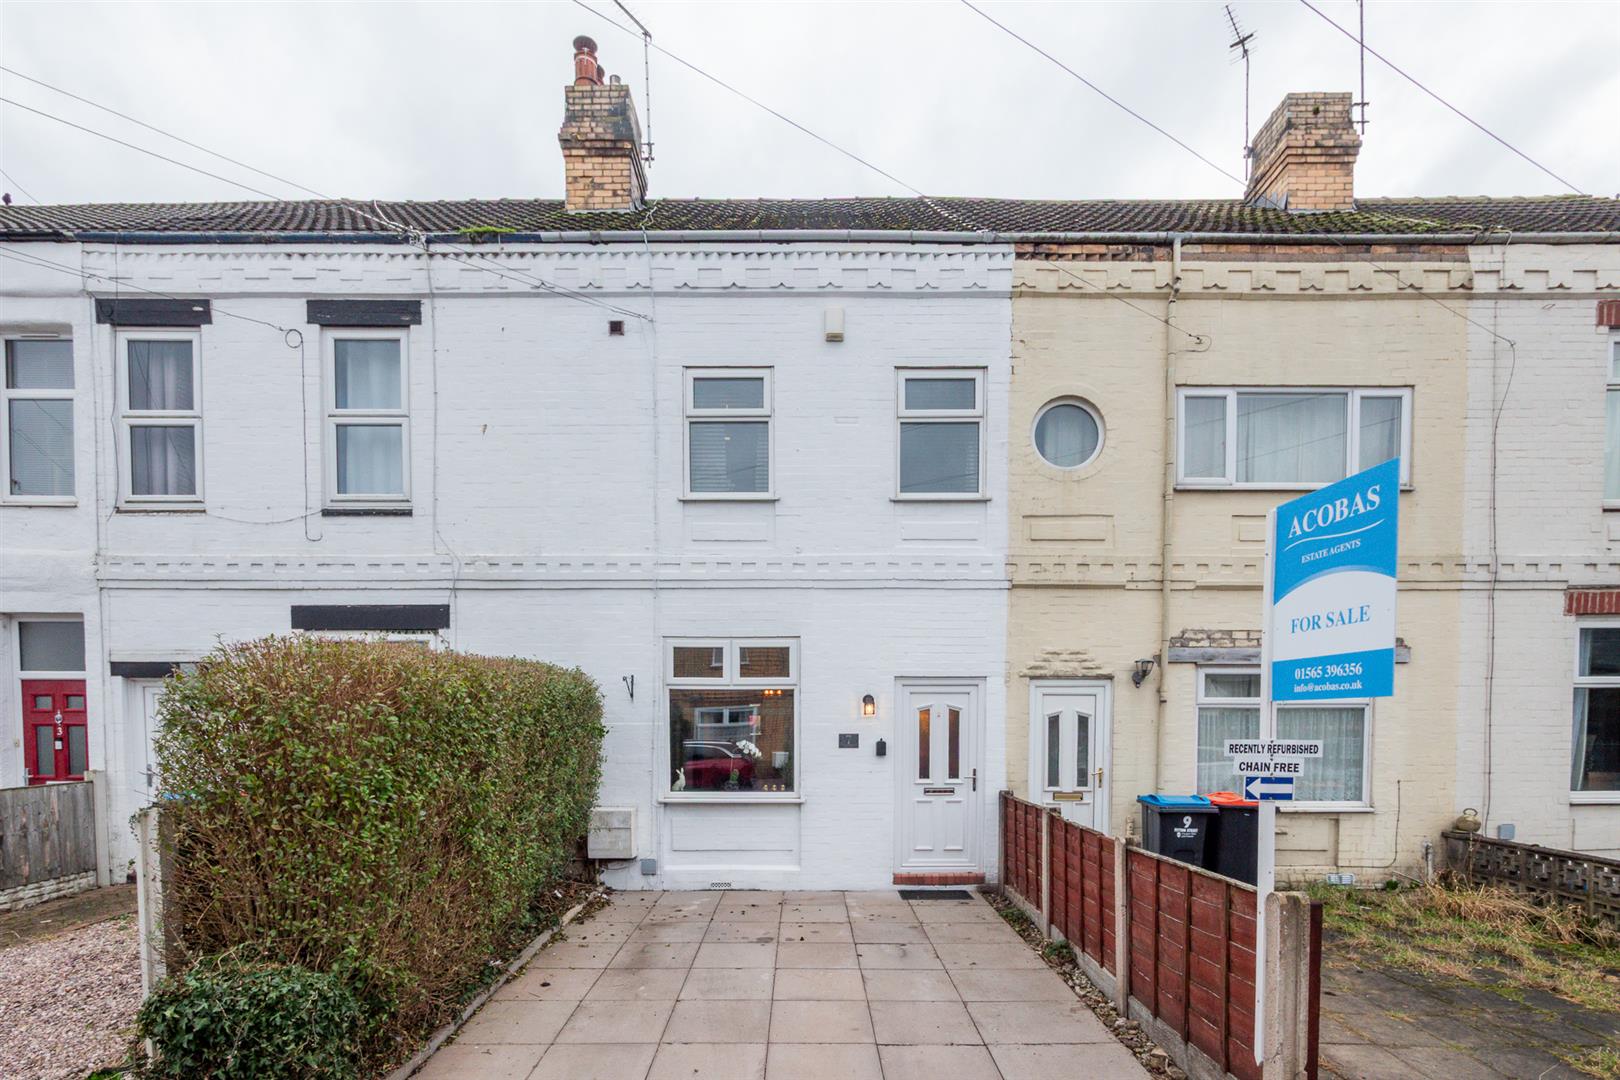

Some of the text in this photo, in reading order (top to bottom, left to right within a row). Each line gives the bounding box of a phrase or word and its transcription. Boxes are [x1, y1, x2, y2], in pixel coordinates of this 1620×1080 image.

[1288, 484, 1380, 538] ACOBAS
[1301, 539, 1361, 563] ESTATE AGENTS
[1291, 605, 1371, 634] FOR SALE
[1295, 662, 1363, 679] 01565 396356
[1294, 680, 1363, 693] info@acobas.co.uk
[56, 727, 63, 736] 3
[1229, 743, 1319, 754] RECENTLY REFURBISHED
[1239, 762, 1300, 773] CHAIN FREE
[1183, 816, 1192, 828] 9
